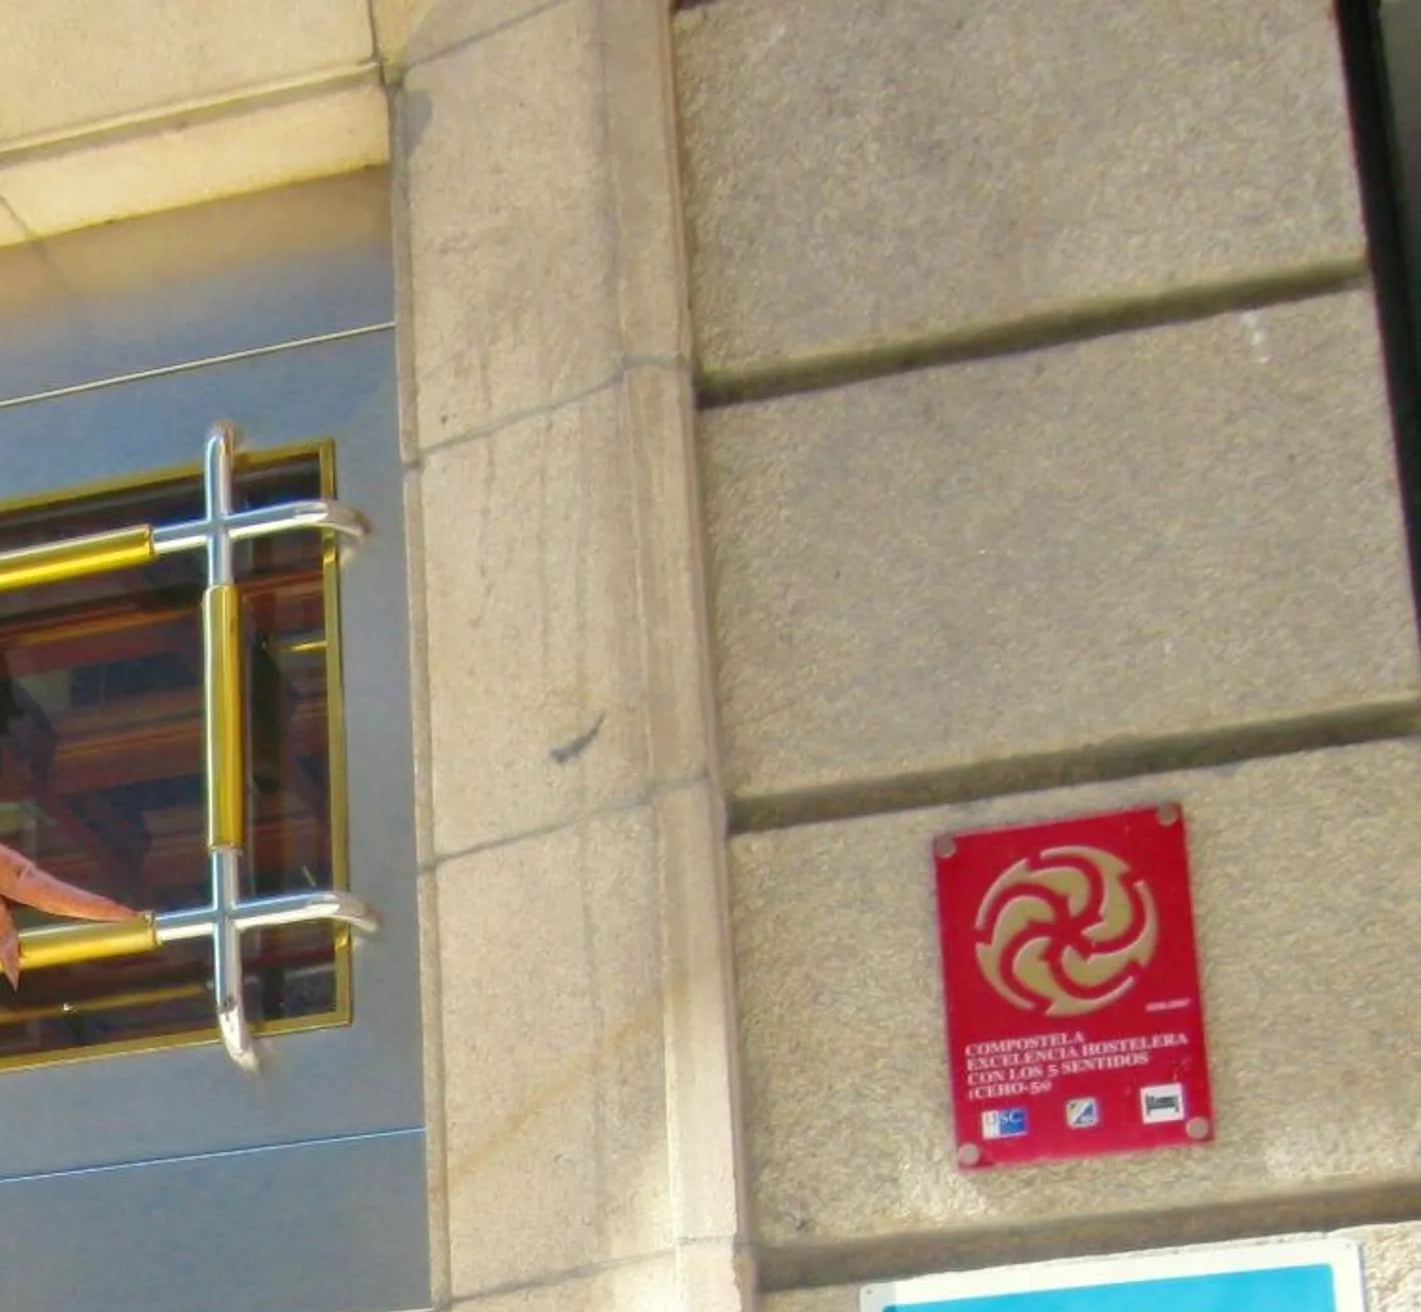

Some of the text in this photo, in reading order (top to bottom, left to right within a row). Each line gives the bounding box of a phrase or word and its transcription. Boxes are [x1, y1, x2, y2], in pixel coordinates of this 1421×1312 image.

[965, 1030, 1084, 1057] COMPOSTELA
[967, 1032, 1189, 1071] EXCELENCIA HOSTELERA
[967, 1051, 1150, 1086] CON LOS 5 SENTIDOS
